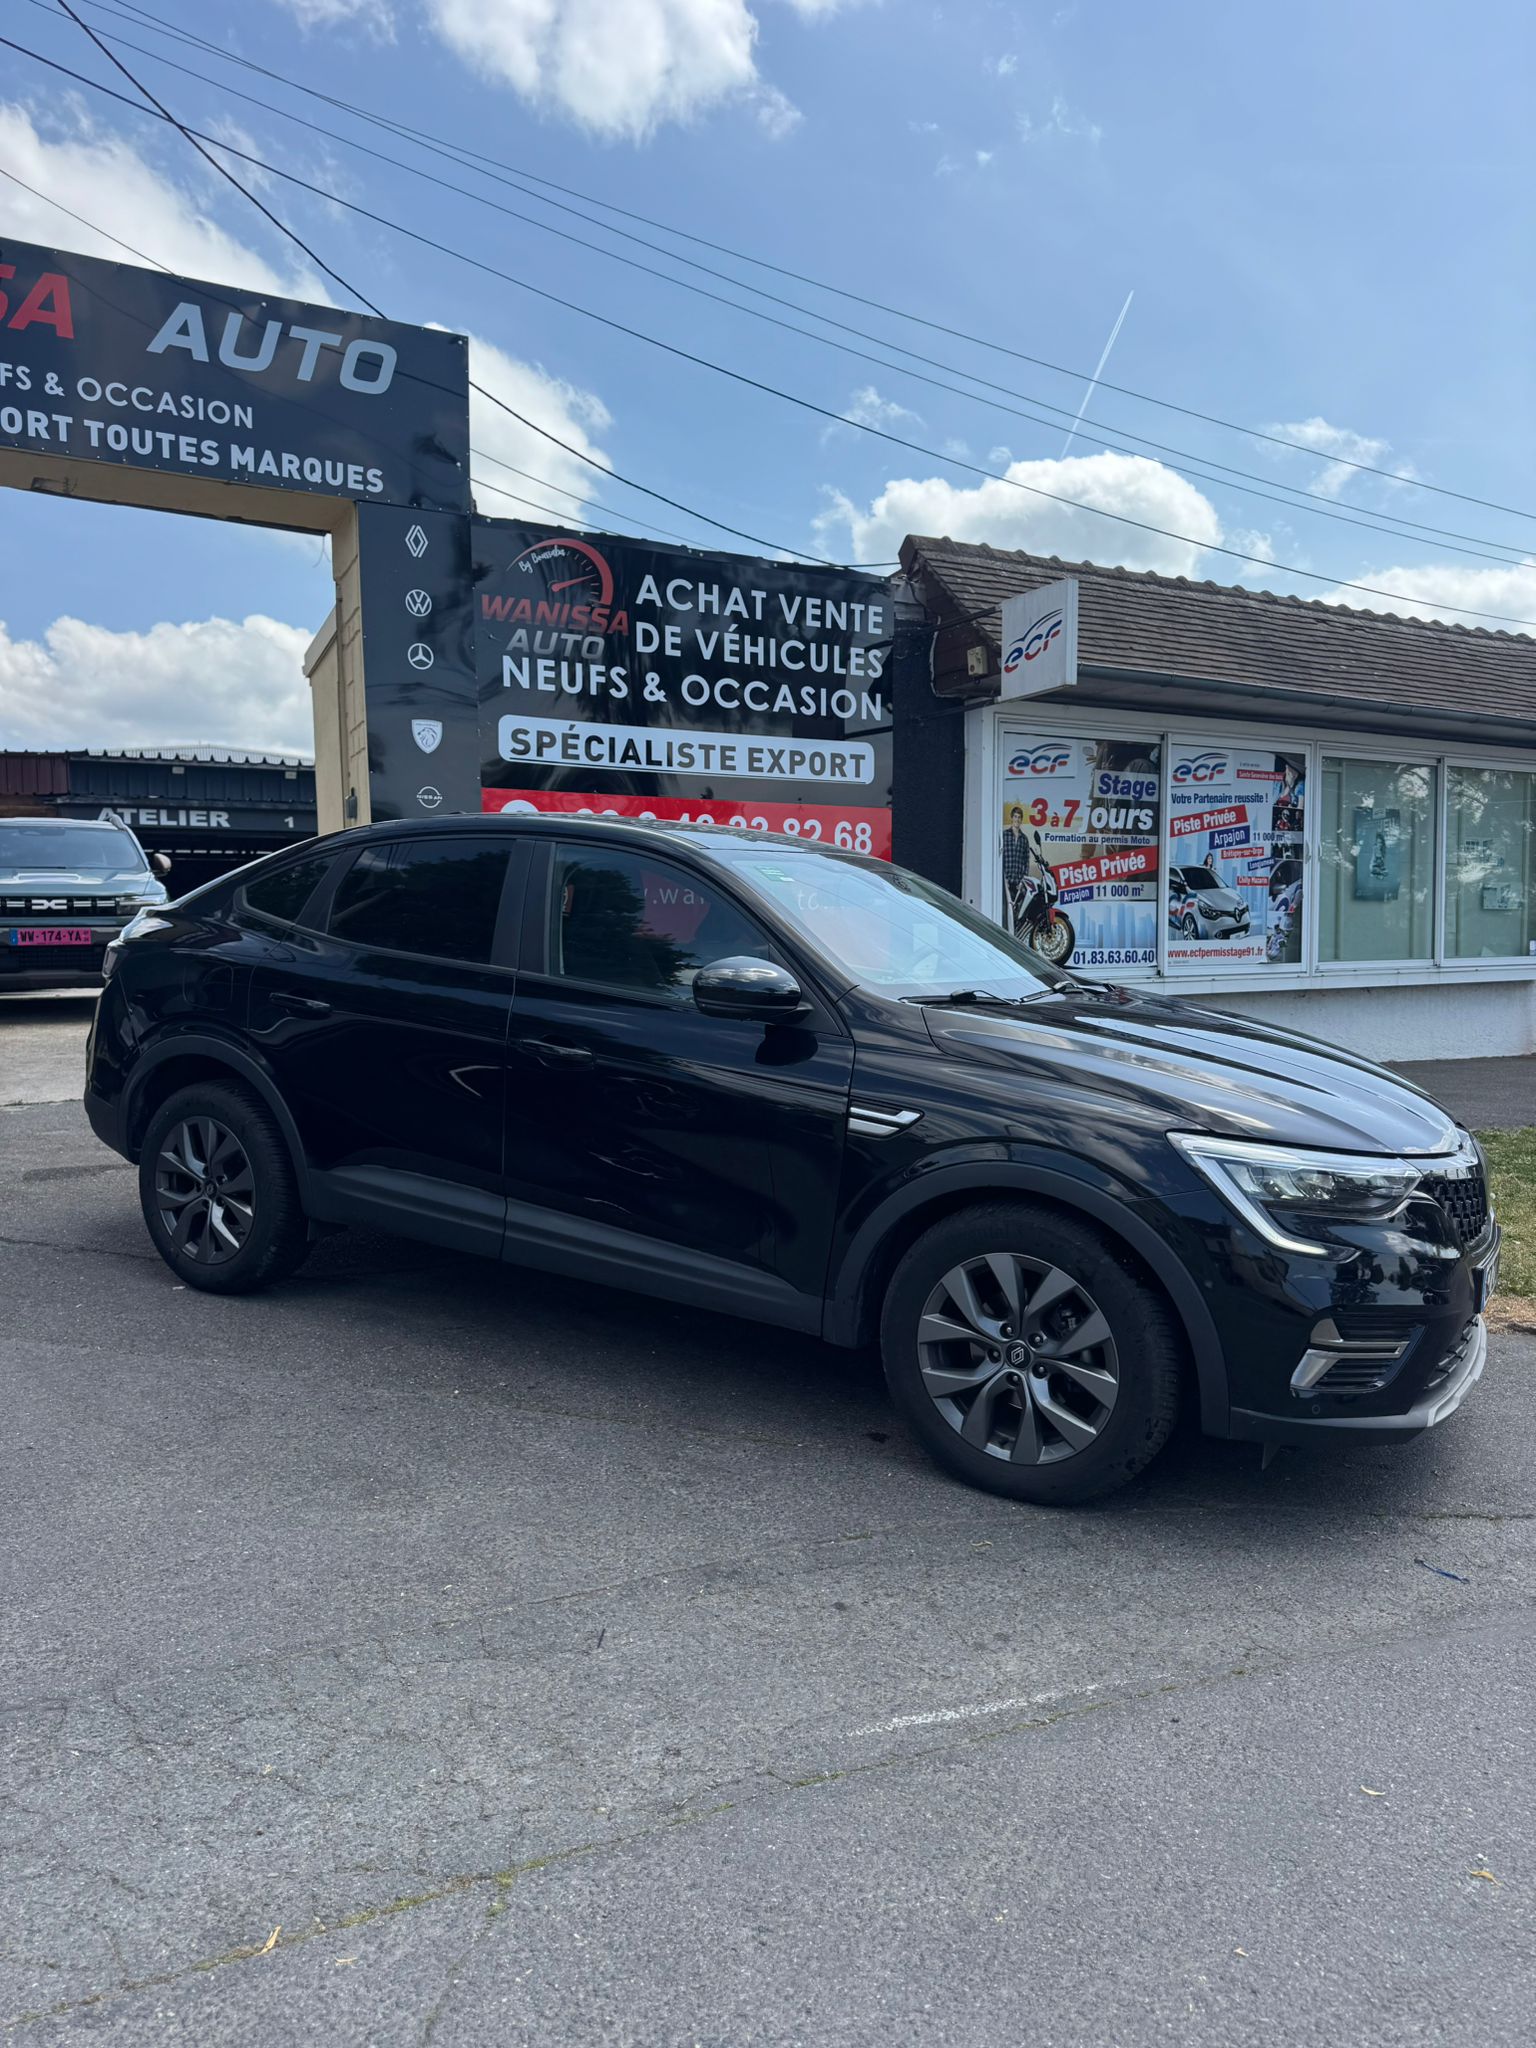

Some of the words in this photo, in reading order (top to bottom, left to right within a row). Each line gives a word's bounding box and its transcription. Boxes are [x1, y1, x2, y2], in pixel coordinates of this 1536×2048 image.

[146, 302, 398, 395] AUTO
[44, 372, 65, 396] &
[77, 377, 253, 429] OCCASION
[83, 419, 220, 466] TOUTES
[231, 444, 384, 493] MARQUES
[481, 594, 629, 636] WANISSA
[636, 574, 766, 620] ACHAT
[779, 593, 883, 635] VENTE
[506, 628, 605, 660] AUTO
[635, 621, 681, 657] DE
[695, 624, 883, 678] VÉHICULES
[503, 655, 628, 699] NEUFS
[643, 672, 667, 702] &
[681, 674, 882, 721] OCCASION
[510, 724, 736, 771] SPÉCIALISTE
[748, 747, 866, 778] EXPORT
[1098, 773, 1156, 801] Stage
[1171, 793, 1191, 804] Votre
[1194, 793, 1232, 804] Partenaire
[98, 807, 231, 828] ATELIER
[284, 816, 294, 829] 1
[1029, 798, 1049, 827] 3
[1050, 812, 1060, 827] à
[1064, 800, 1080, 827] 7
[1173, 817, 1200, 835] Piste
[1203, 809, 1236, 828] Privée
[835, 821, 872, 855] 68
[1045, 833, 1086, 843] Formation
[1101, 835, 1128, 845] permis
[1131, 836, 1150, 845] Moto
[1214, 829, 1245, 846] Arpajon
[1253, 832, 1260, 841] 11
[1263, 832, 1275, 841] 000
[1059, 863, 1097, 886] Piste
[1100, 852, 1146, 877] Privée
[1064, 888, 1089, 903] Arpajon
[1096, 886, 1107, 897] 11
[1111, 885, 1129, 897] 000
[1073, 950, 1154, 965] 01.83.63.60.40
[1168, 946, 1263, 959] www.ecfpermisstage91.fr
